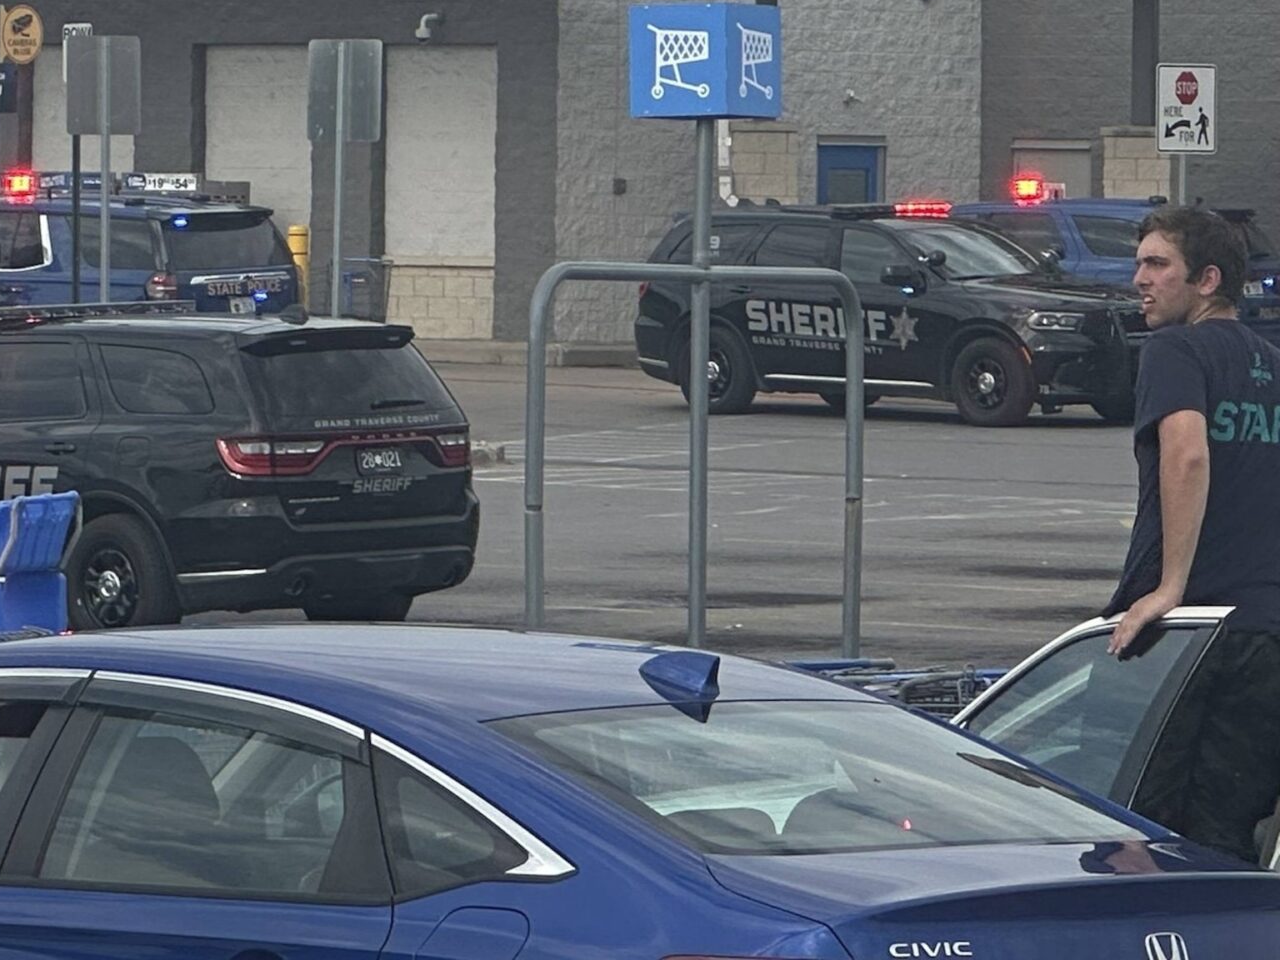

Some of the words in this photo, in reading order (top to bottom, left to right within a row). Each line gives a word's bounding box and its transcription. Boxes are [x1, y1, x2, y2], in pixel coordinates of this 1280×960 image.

[1176, 81, 1197, 95] STOP
[1164, 106, 1183, 117] HERE
[1179, 131, 1195, 142] FOR
[207, 282, 242, 296] STATE
[247, 280, 282, 294] POLICE
[745, 299, 887, 341] SHERIF
[789, 339, 841, 351] TRAVERSE
[314, 419, 350, 428] GRAND
[355, 416, 403, 426] TRAVERSE
[407, 414, 440, 424] COUNTY
[353, 476, 412, 493] SHERIFF
[889, 942, 973, 958] CIVIC
